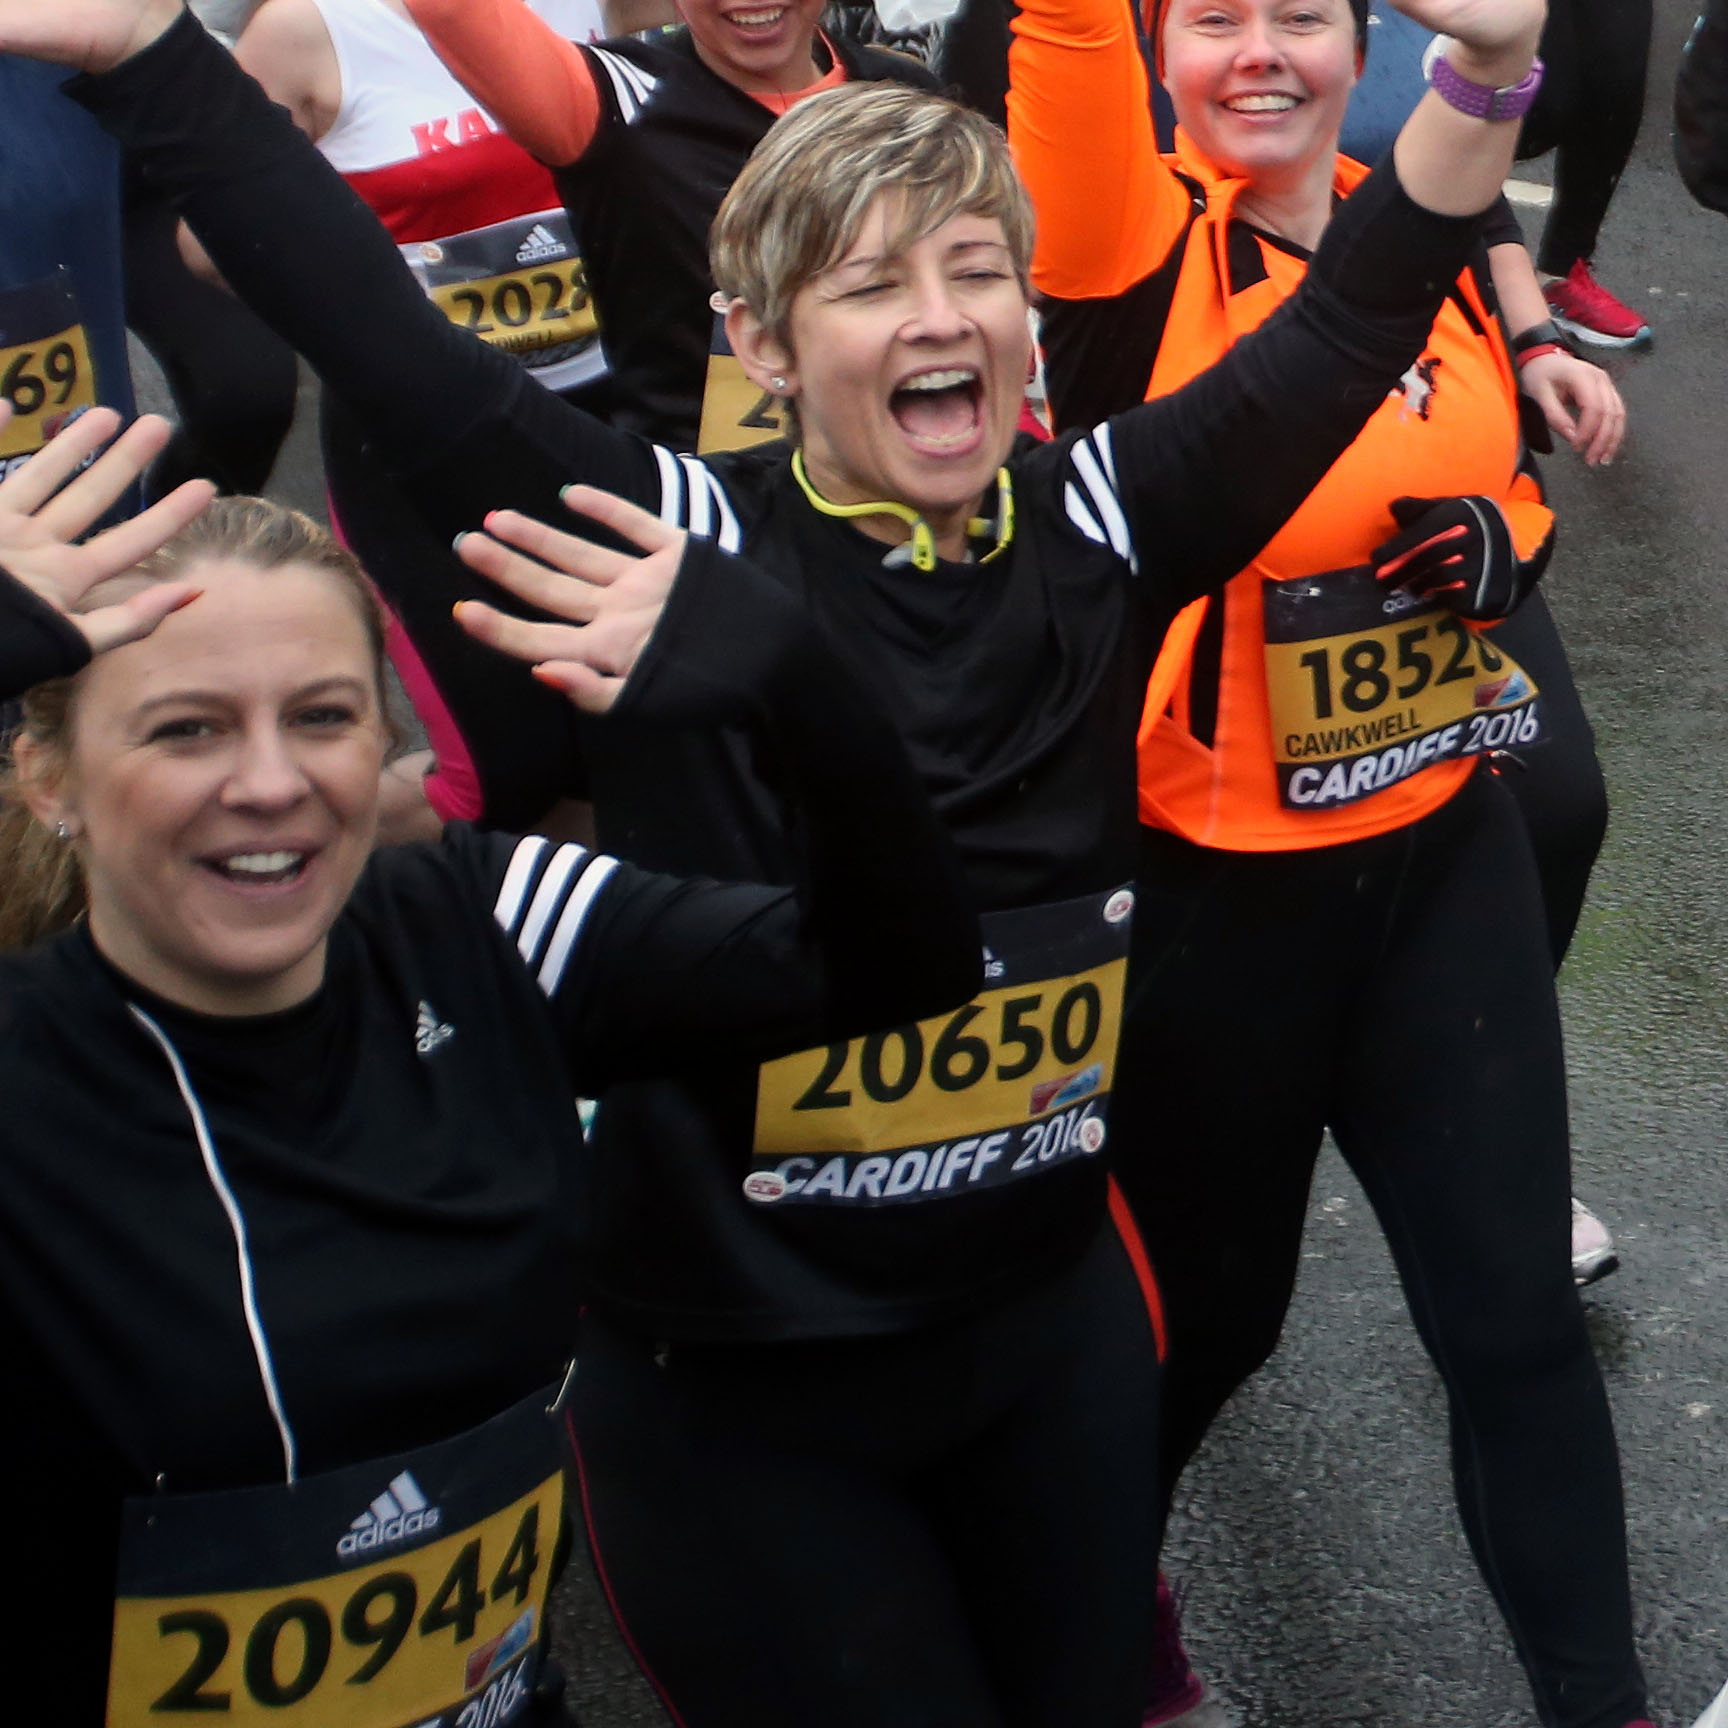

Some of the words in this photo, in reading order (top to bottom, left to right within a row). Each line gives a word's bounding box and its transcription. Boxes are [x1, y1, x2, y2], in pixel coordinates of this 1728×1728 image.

[516, 240, 566, 262] adidas
[1285, 708, 1422, 759] CAWKWELL
[1287, 722, 1462, 805] CARDIFF
[1460, 702, 1539, 753] 2016
[794, 982, 1101, 1110] 20650
[773, 1134, 1008, 1201] CARDIFF
[337, 1505, 441, 1557] adidas
[149, 1502, 546, 1712] 20944
